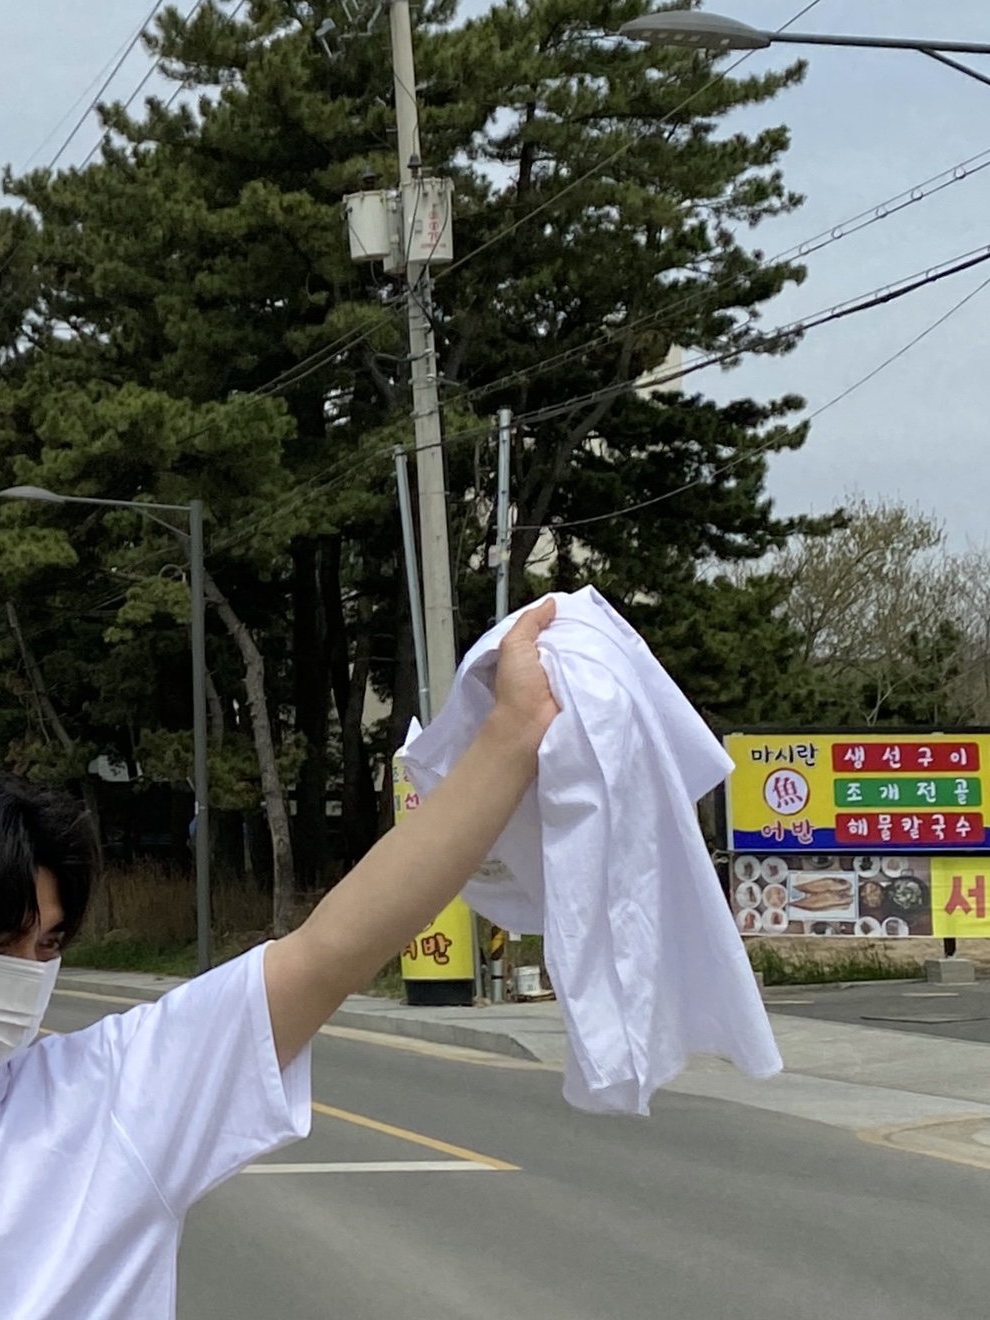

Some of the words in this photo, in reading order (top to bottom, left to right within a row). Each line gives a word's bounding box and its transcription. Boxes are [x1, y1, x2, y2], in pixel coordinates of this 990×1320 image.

[751, 743, 819, 767] 마시란
[843, 746, 968, 769] 생선구이
[773, 777, 803, 808] 魚
[846, 779, 970, 805] 조개전골
[761, 819, 814, 844] 어반
[847, 814, 972, 840] 해물칼국수
[944, 875, 986, 919] 서
